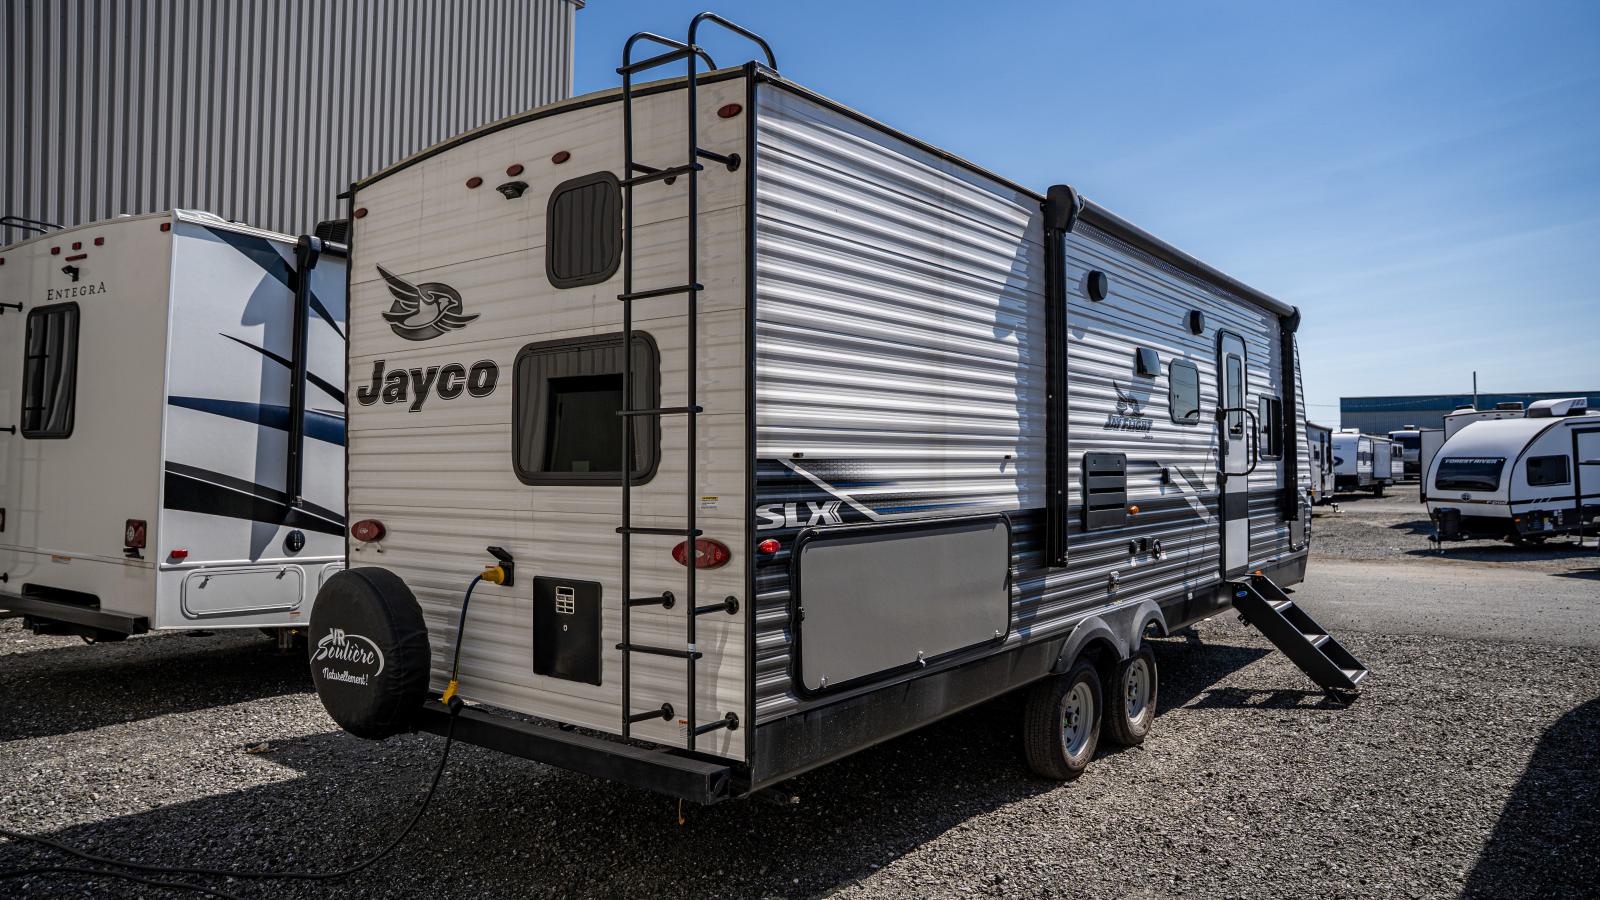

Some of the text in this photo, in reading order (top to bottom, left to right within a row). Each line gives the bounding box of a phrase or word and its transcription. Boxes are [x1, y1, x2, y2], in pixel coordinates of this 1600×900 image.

[47, 281, 106, 301] ENTEGRA
[356, 359, 500, 413] Jayco
[755, 501, 843, 530] SLX
